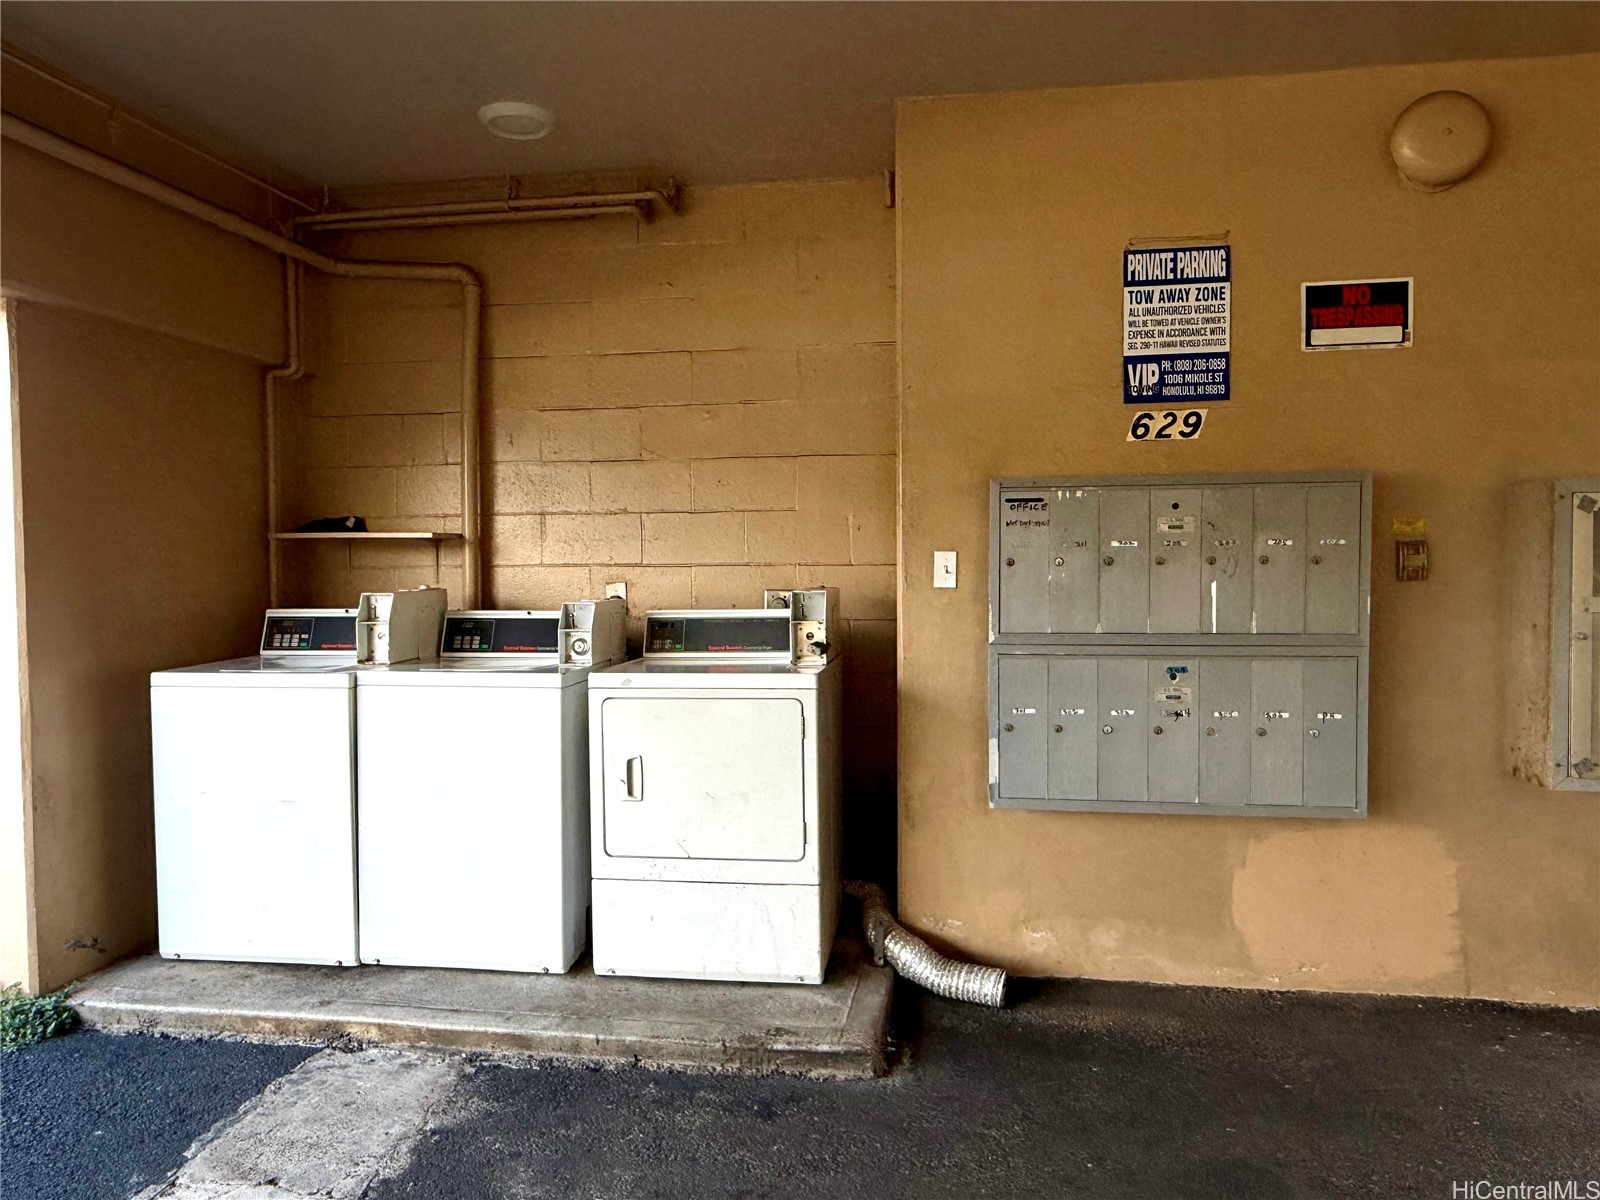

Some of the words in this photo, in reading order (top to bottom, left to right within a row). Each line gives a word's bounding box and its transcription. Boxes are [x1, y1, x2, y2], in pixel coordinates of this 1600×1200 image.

[1127, 252, 1174, 281] PRIVATE
[1177, 249, 1226, 279] PARKING
[1128, 289, 1154, 305] TOW
[1158, 287, 1191, 304] AWAY
[1195, 285, 1226, 302] ZONE
[1342, 284, 1371, 306] NO
[1128, 307, 1140, 318] ALL
[1142, 305, 1193, 317] UNAUTHORIZED
[1193, 303, 1226, 315] VEHICLES
[1311, 304, 1404, 328] TRESPASSING
[1128, 319, 1140, 328] WILL
[1141, 319, 1149, 328] BE
[1150, 318, 1169, 327] TOWED
[1170, 318, 1177, 326] AT
[1177, 316, 1200, 326] VEHICLE
[1201, 315, 1227, 325] OWNER'S
[1127, 329, 1156, 340] EXPENSE
[1157, 328, 1164, 338] IN
[1165, 326, 1208, 338] ACCORDANCE
[1209, 326, 1226, 336] WITH
[1140, 340, 1158, 350] 290-11
[1159, 340, 1178, 348] HAWAII
[1179, 338, 1200, 348] REVISED
[1201, 337, 1227, 347] STATUTES
[1161, 360, 1173, 372] PH:
[1127, 362, 1159, 396] VIP
[1164, 374, 1183, 384] 1006
[1184, 372, 1213, 383] MIKOLE
[1214, 372, 1224, 382] ST
[1162, 385, 1197, 396] HONOLULU,
[1197, 384, 1205, 395] HI
[1205, 384, 1226, 395] 96819
[1130, 410, 1203, 440] 629
[1009, 502, 1048, 512] OFFICE
